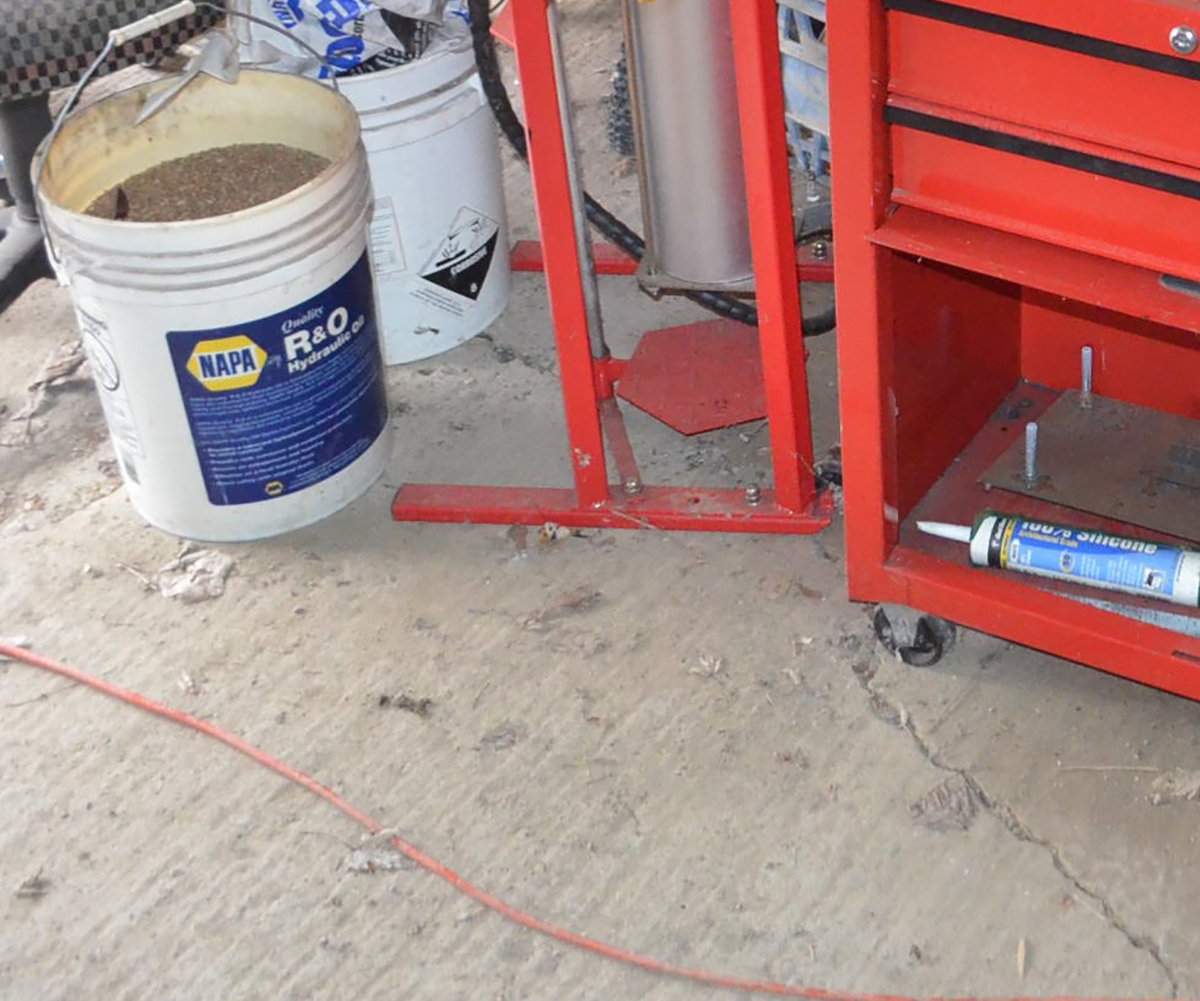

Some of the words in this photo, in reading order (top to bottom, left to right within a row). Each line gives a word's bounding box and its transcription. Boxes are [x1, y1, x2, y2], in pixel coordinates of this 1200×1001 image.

[281, 306, 324, 335] Quality
[284, 306, 348, 361] R&O
[198, 348, 256, 379] NAPA
[288, 331, 352, 374] Hydraulic
